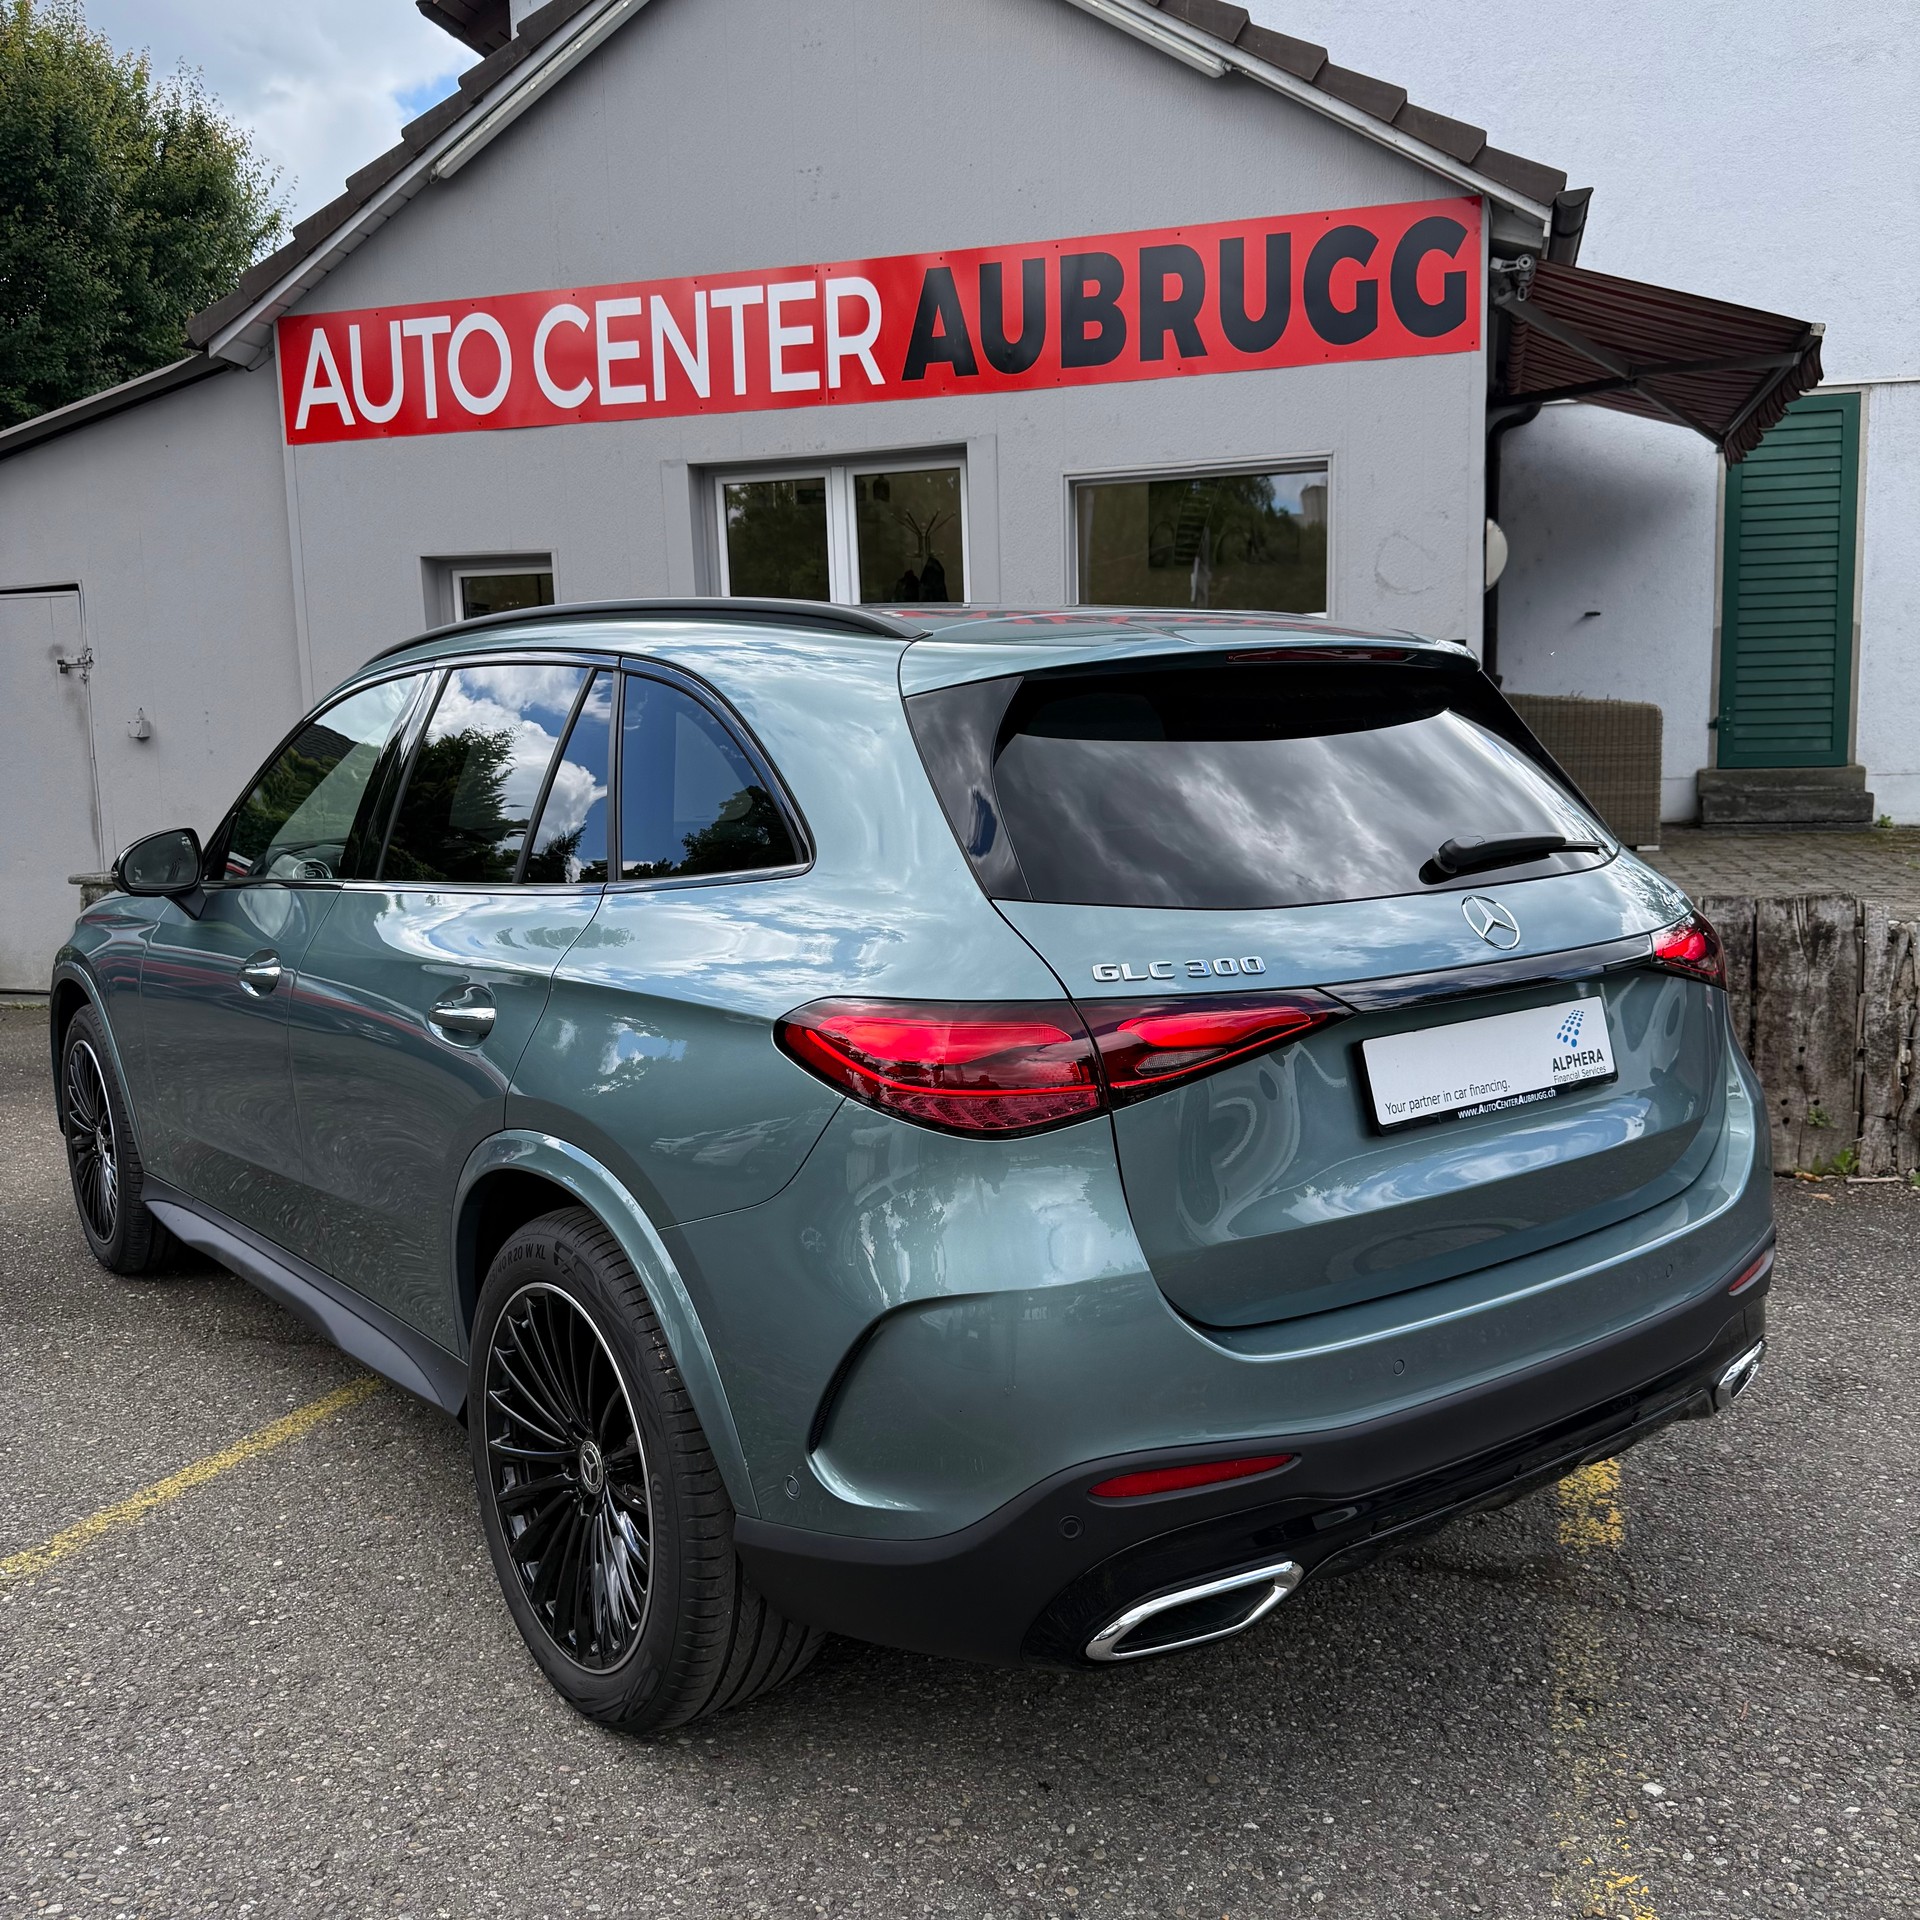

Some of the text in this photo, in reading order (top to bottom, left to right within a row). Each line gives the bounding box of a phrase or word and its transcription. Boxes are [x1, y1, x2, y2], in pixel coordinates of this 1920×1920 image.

[295, 216, 1469, 430] AUTO CENTER AUBRUGG
[1092, 956, 1267, 982] GLC 300
[1553, 1048, 1605, 1073] ALPHERA
[1553, 1064, 1607, 1084] Financial Services
[1385, 1079, 1511, 1115] Your partner in car financing.
[525, 1243, 534, 1258] W
[535, 1243, 546, 1260] XL
